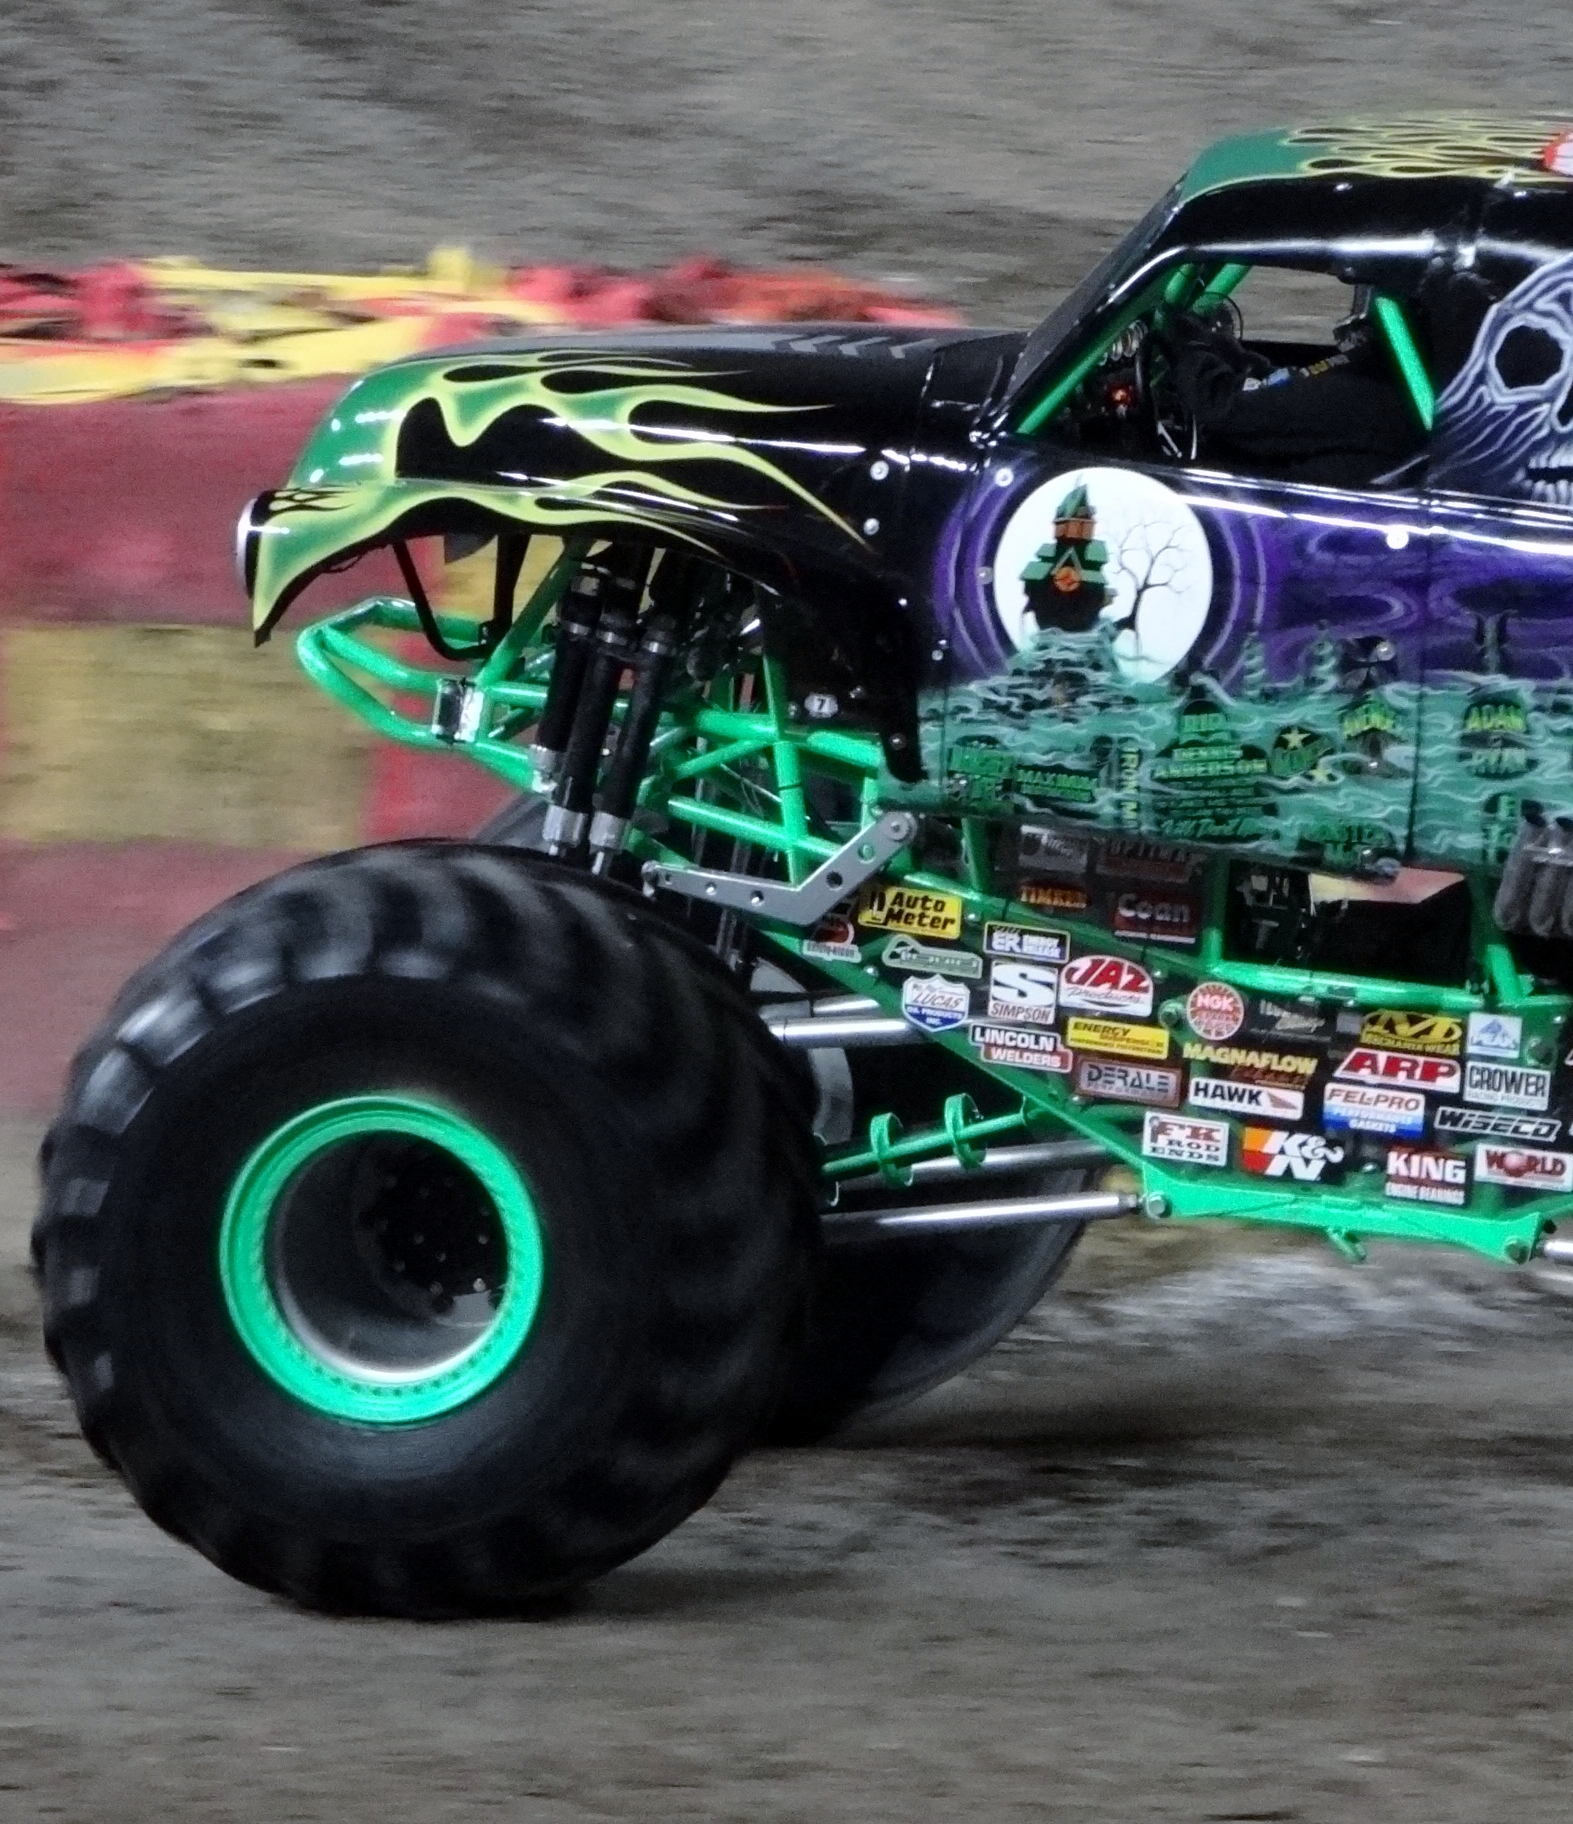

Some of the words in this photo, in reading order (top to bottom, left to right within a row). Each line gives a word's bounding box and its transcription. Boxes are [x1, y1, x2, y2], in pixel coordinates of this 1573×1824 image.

[891, 890, 946, 912] Auto
[1117, 892, 1191, 923] Coan
[885, 908, 956, 930] Meter
[1064, 957, 1151, 995] JAZ
[912, 991, 964, 1010] LUCAS
[991, 1002, 1052, 1022] SIMPSON
[1196, 993, 1234, 1012] NGK
[974, 1026, 1055, 1052] LINCOLN
[991, 1048, 1062, 1068] WELDERS
[1183, 1042, 1318, 1075] MAGNAFLOW
[1342, 1052, 1459, 1083] ARP
[1086, 1064, 1171, 1094] DERALE
[1468, 1065, 1547, 1098] CROWER
[1193, 1080, 1264, 1106] HAWK
[1157, 1120, 1222, 1143] FK
[1150, 1146, 1221, 1162] ENDS
[1166, 1138, 1221, 1153] ROD
[1387, 1149, 1466, 1184] KING
